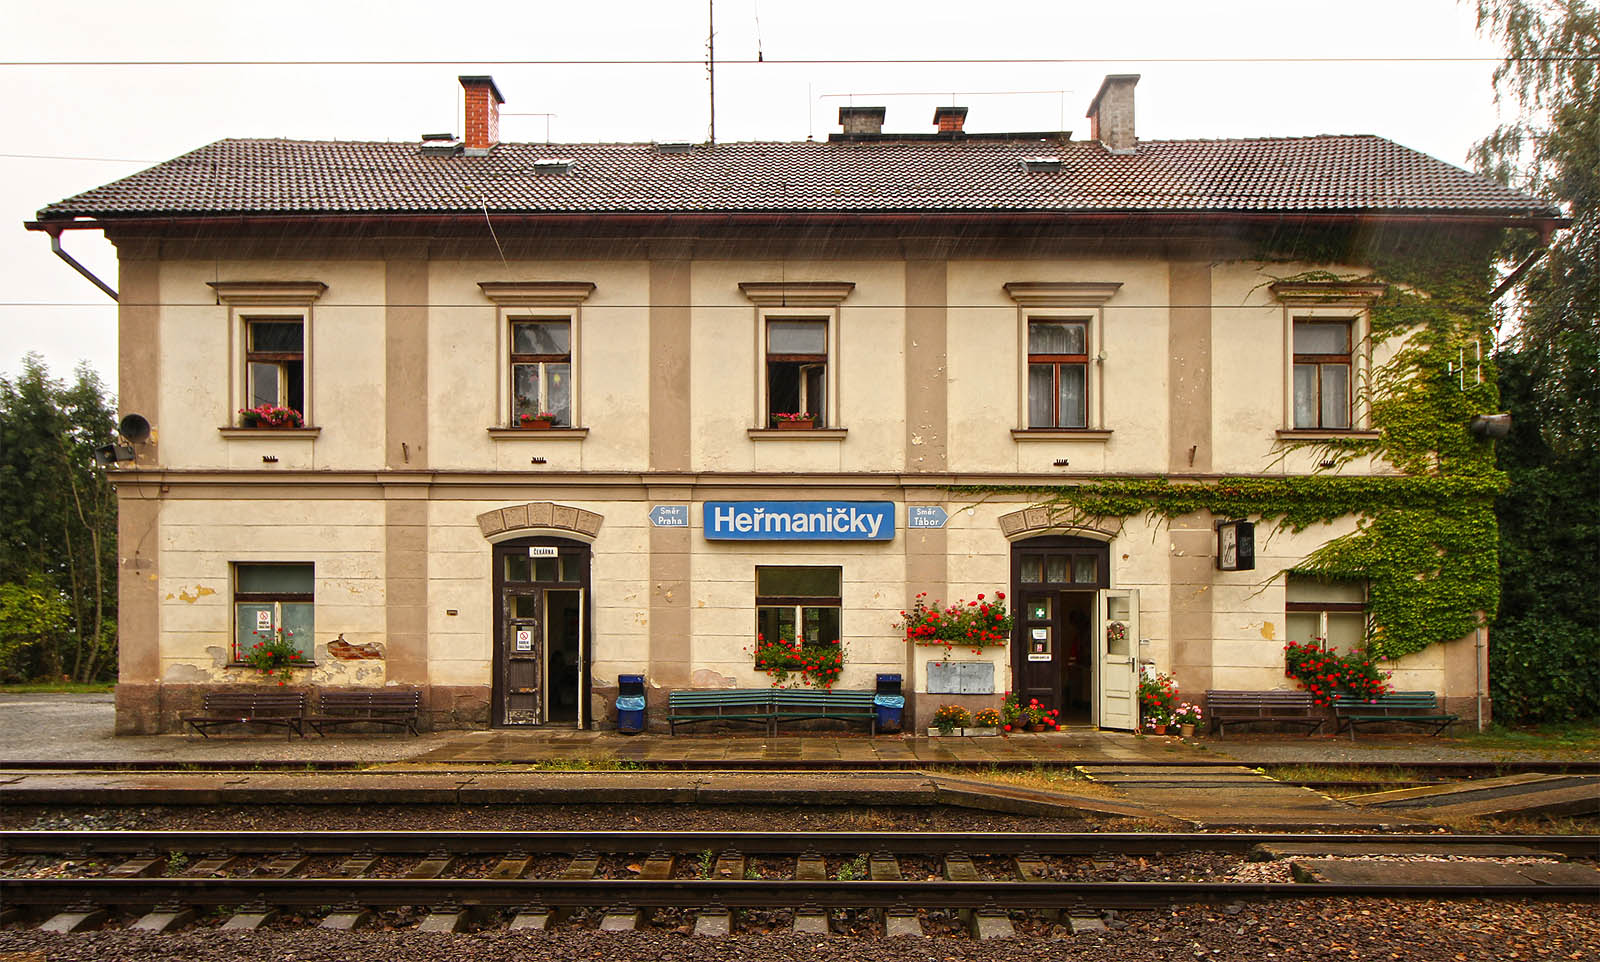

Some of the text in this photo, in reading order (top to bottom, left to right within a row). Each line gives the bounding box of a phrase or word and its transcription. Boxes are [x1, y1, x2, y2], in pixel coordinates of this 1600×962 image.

[658, 516, 682, 525] Praha
[714, 507, 883, 537] Heřmaničky
[914, 517, 939, 526] Tábor
